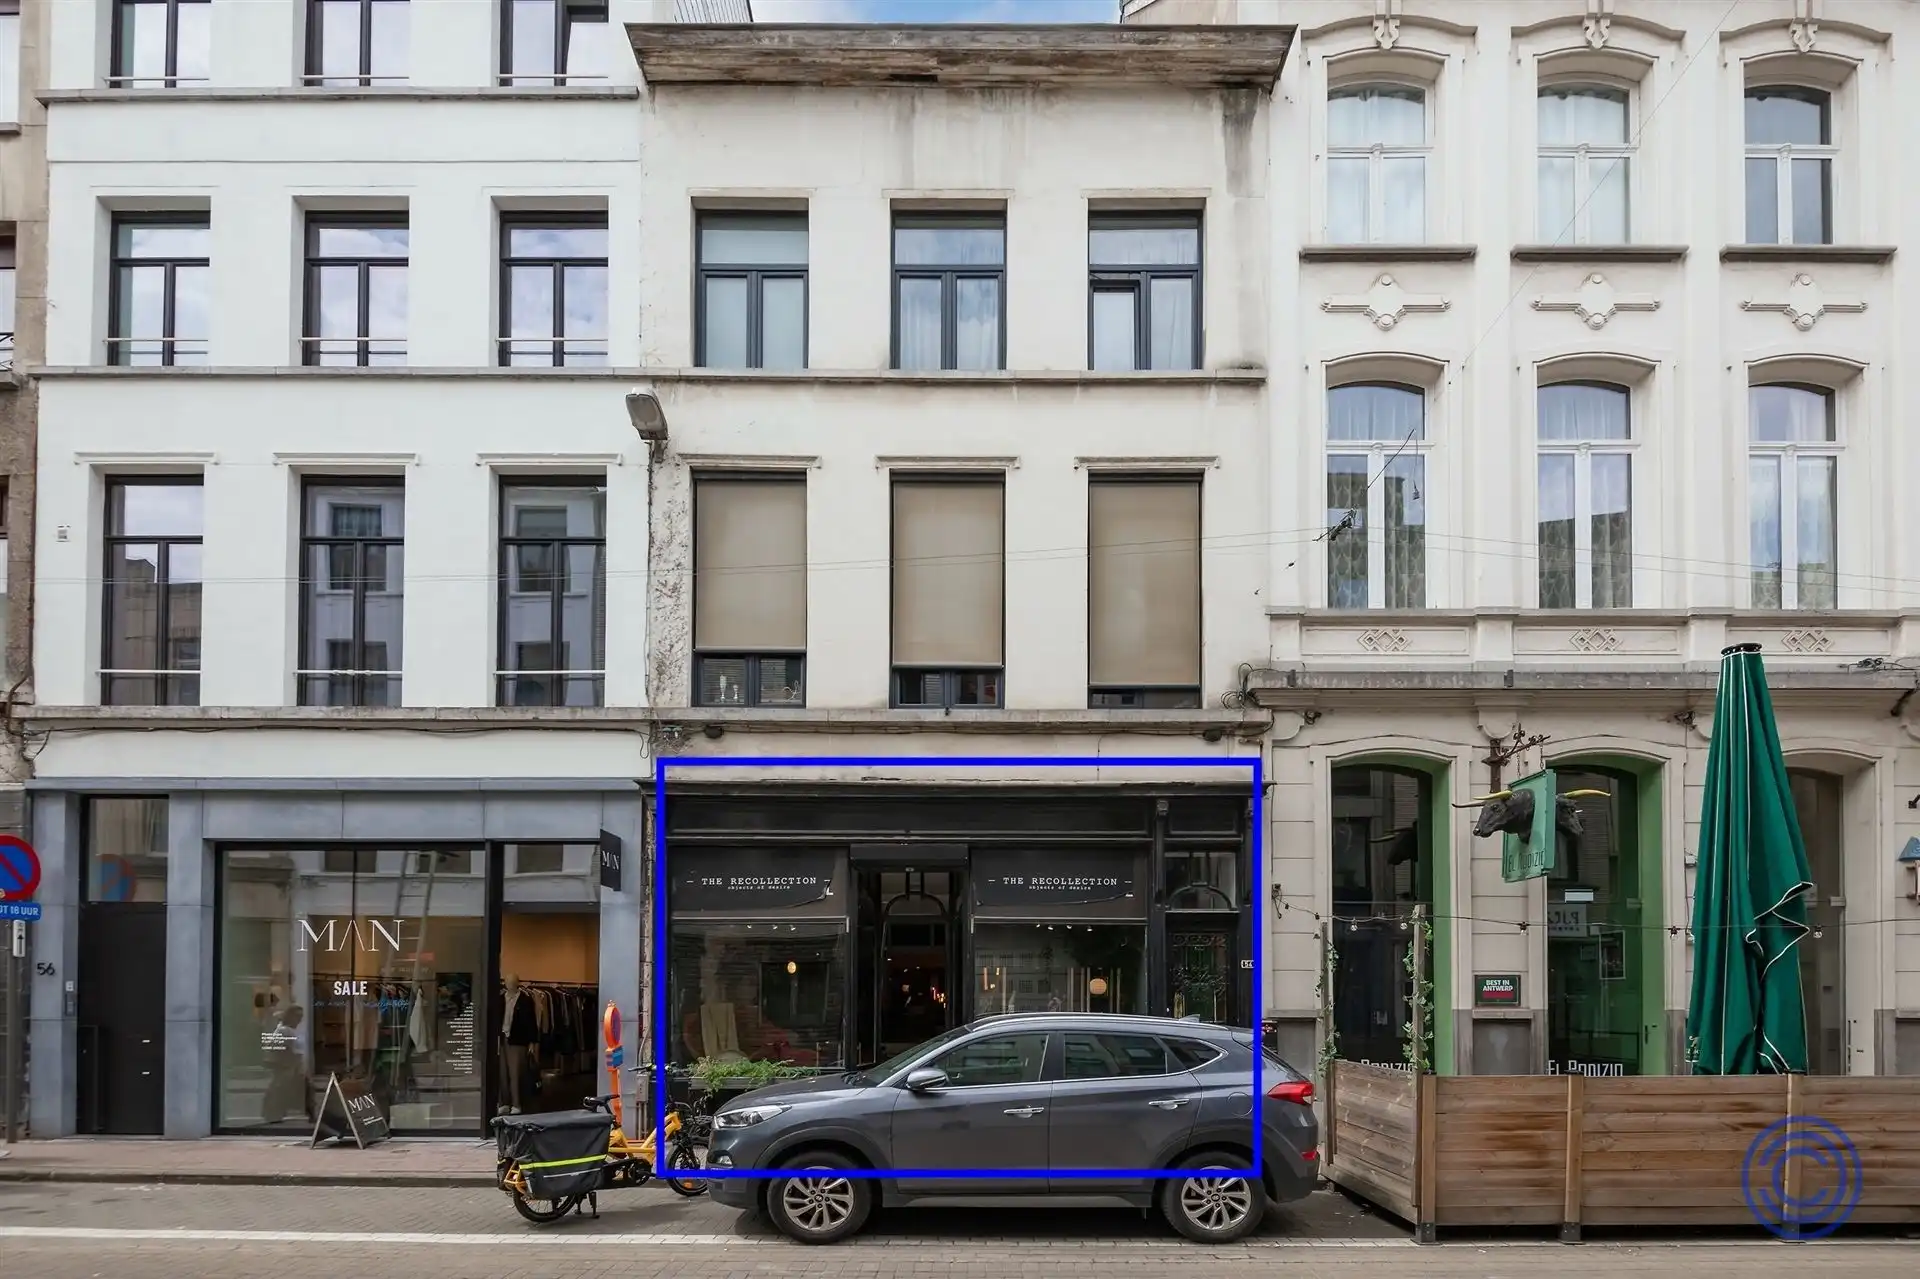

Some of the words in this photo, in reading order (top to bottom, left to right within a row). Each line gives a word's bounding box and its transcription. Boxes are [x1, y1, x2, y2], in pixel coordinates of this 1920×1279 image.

[730, 877, 817, 885] RECOLLECTION
[1003, 877, 1024, 885] THE
[1032, 877, 1118, 886] RECOLLECTION
[10, 906, 20, 915] 18
[20, 906, 40, 916] UUR
[36, 962, 56, 976] 56
[333, 981, 368, 996] SALE
